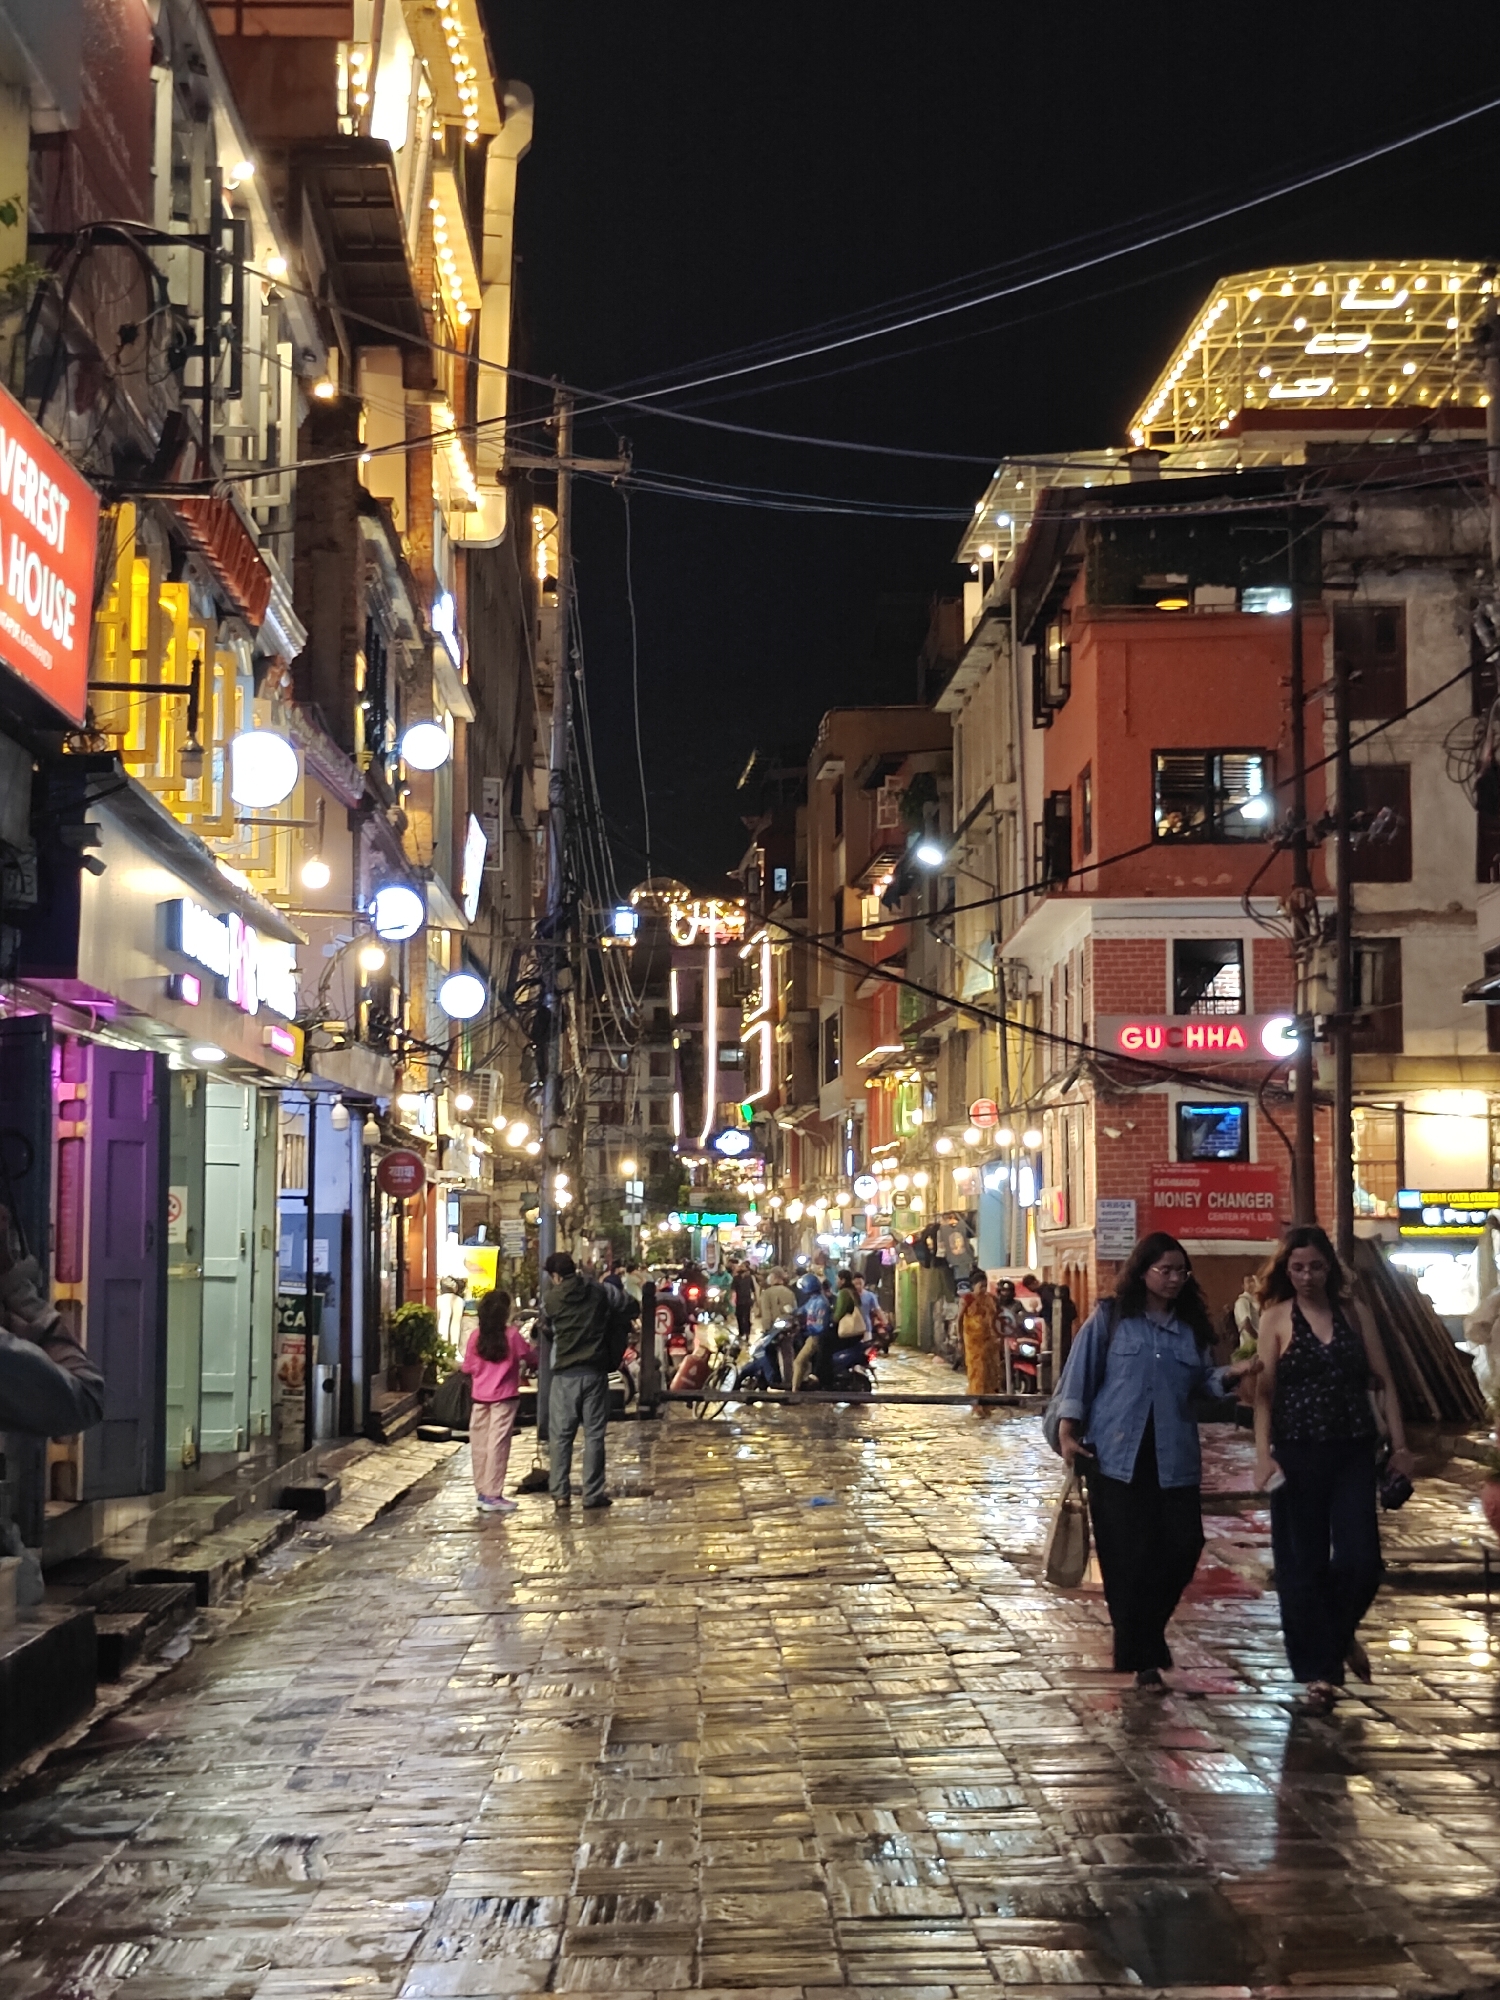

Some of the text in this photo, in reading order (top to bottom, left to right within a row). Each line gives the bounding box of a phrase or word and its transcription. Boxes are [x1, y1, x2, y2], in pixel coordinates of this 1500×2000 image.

[8, 533, 76, 651] HOUSE
[1121, 1025, 1245, 1049] GUCHHA
[1154, 1191, 1274, 1208] MONEY CHANGER
[1207, 1212, 1239, 1221] CENTER
